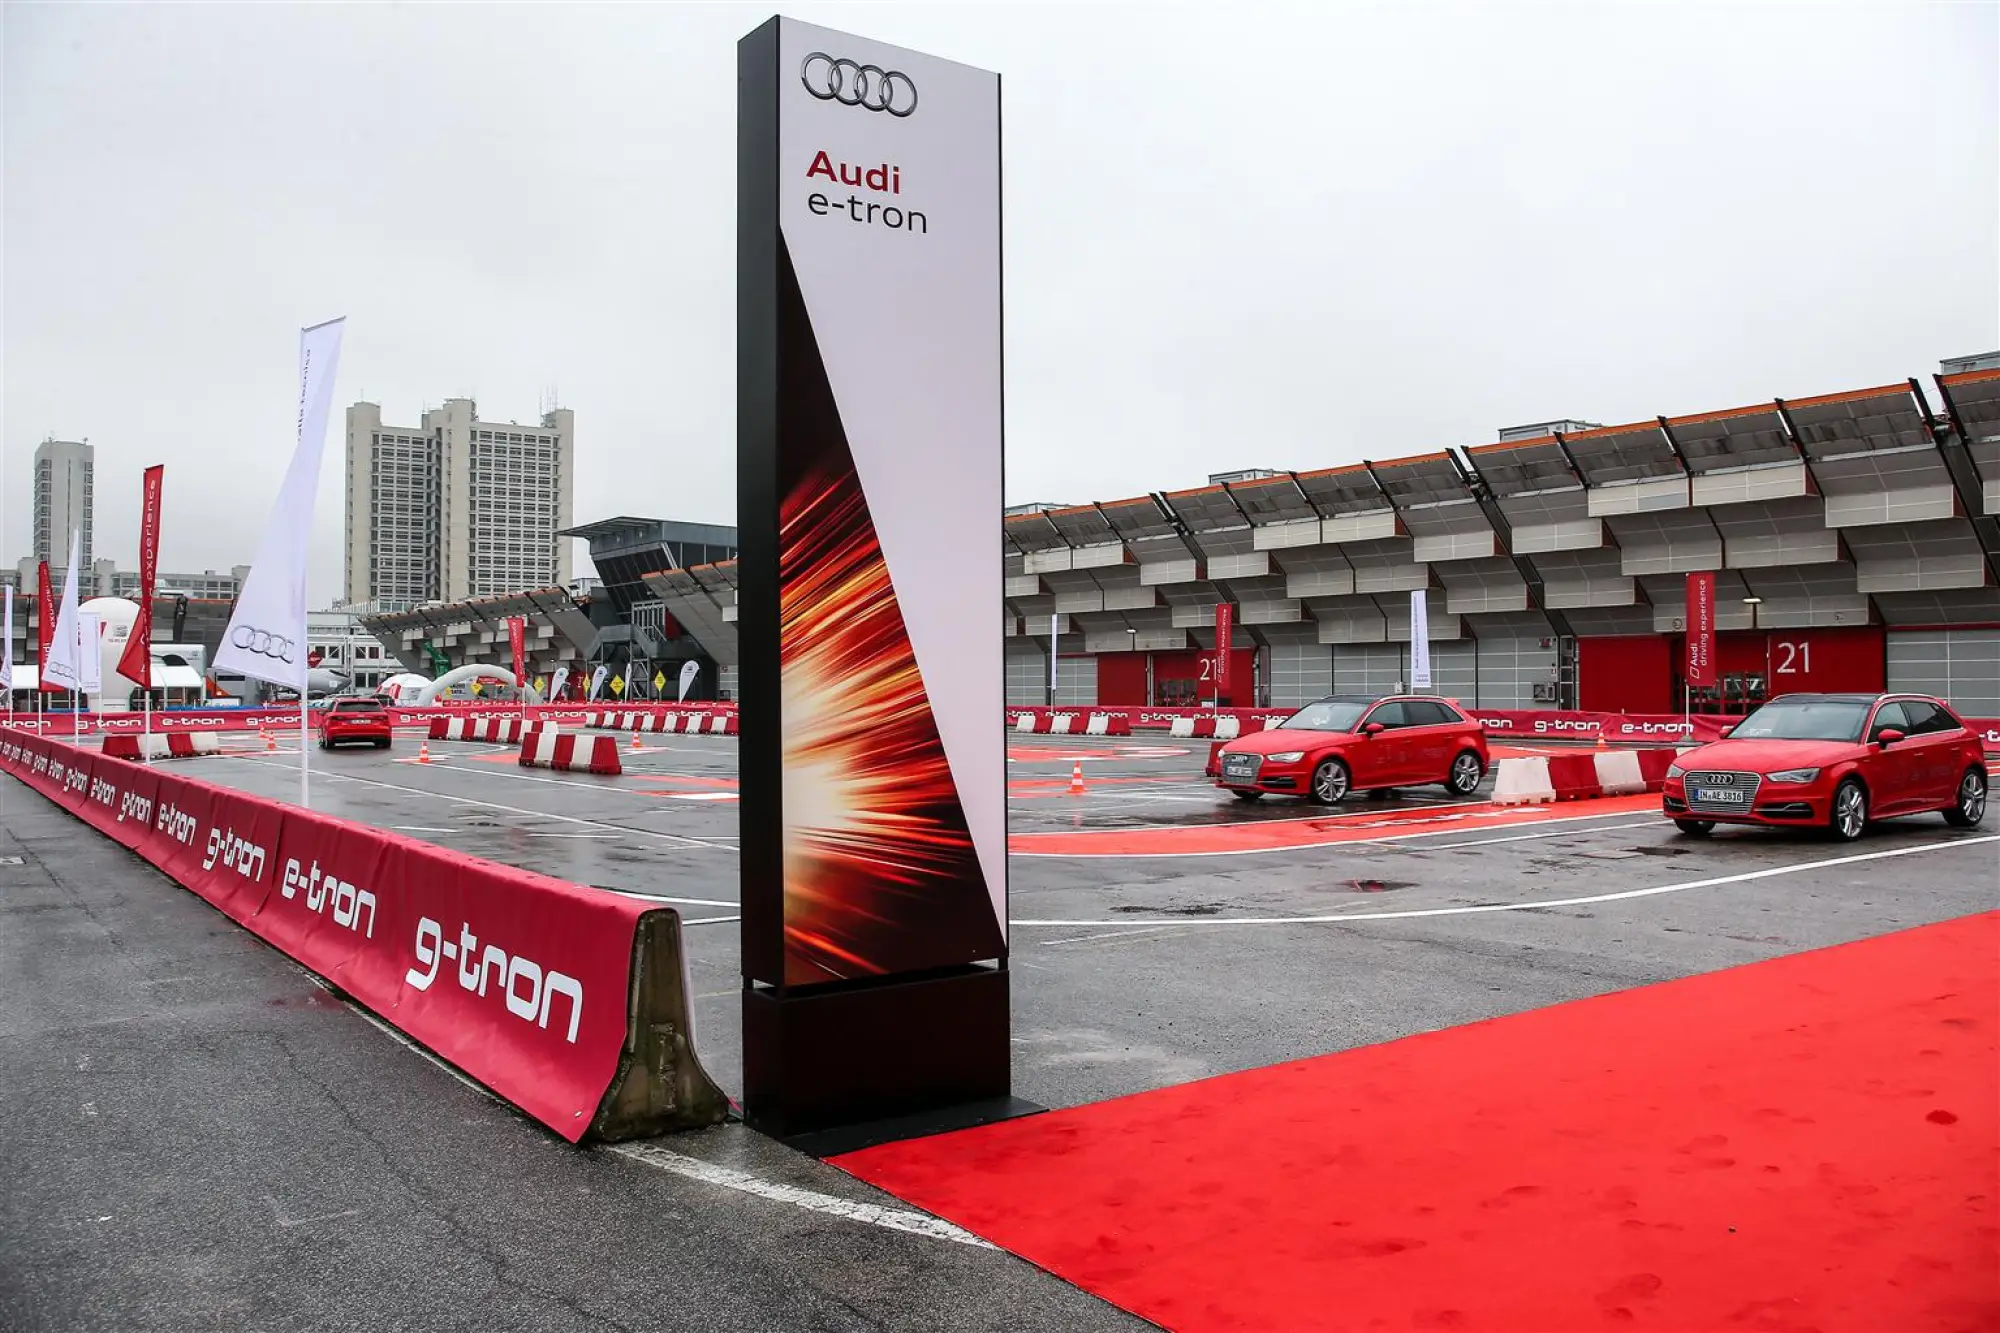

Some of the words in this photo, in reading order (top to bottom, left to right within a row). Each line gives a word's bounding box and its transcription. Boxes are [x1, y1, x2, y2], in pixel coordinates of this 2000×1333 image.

[806, 150, 900, 194] Audi
[807, 193, 927, 234] e-tron
[1699, 579, 1708, 631] experience
[1690, 643, 1698, 666] Audi
[1700, 633, 1709, 666] driving
[1777, 642, 1811, 673] 21
[1200, 658, 1217, 681] 21
[162, 717, 225, 726] e-tron
[1534, 719, 1600, 733] g-tron
[1621, 721, 1694, 734] e-tron
[90, 776, 116, 807] e-tron
[117, 789, 152, 823] g-tron
[158, 802, 196, 847] e-tron
[202, 826, 266, 882] g-tron
[281, 857, 377, 939] e-tron
[405, 916, 583, 1044] g-tron
